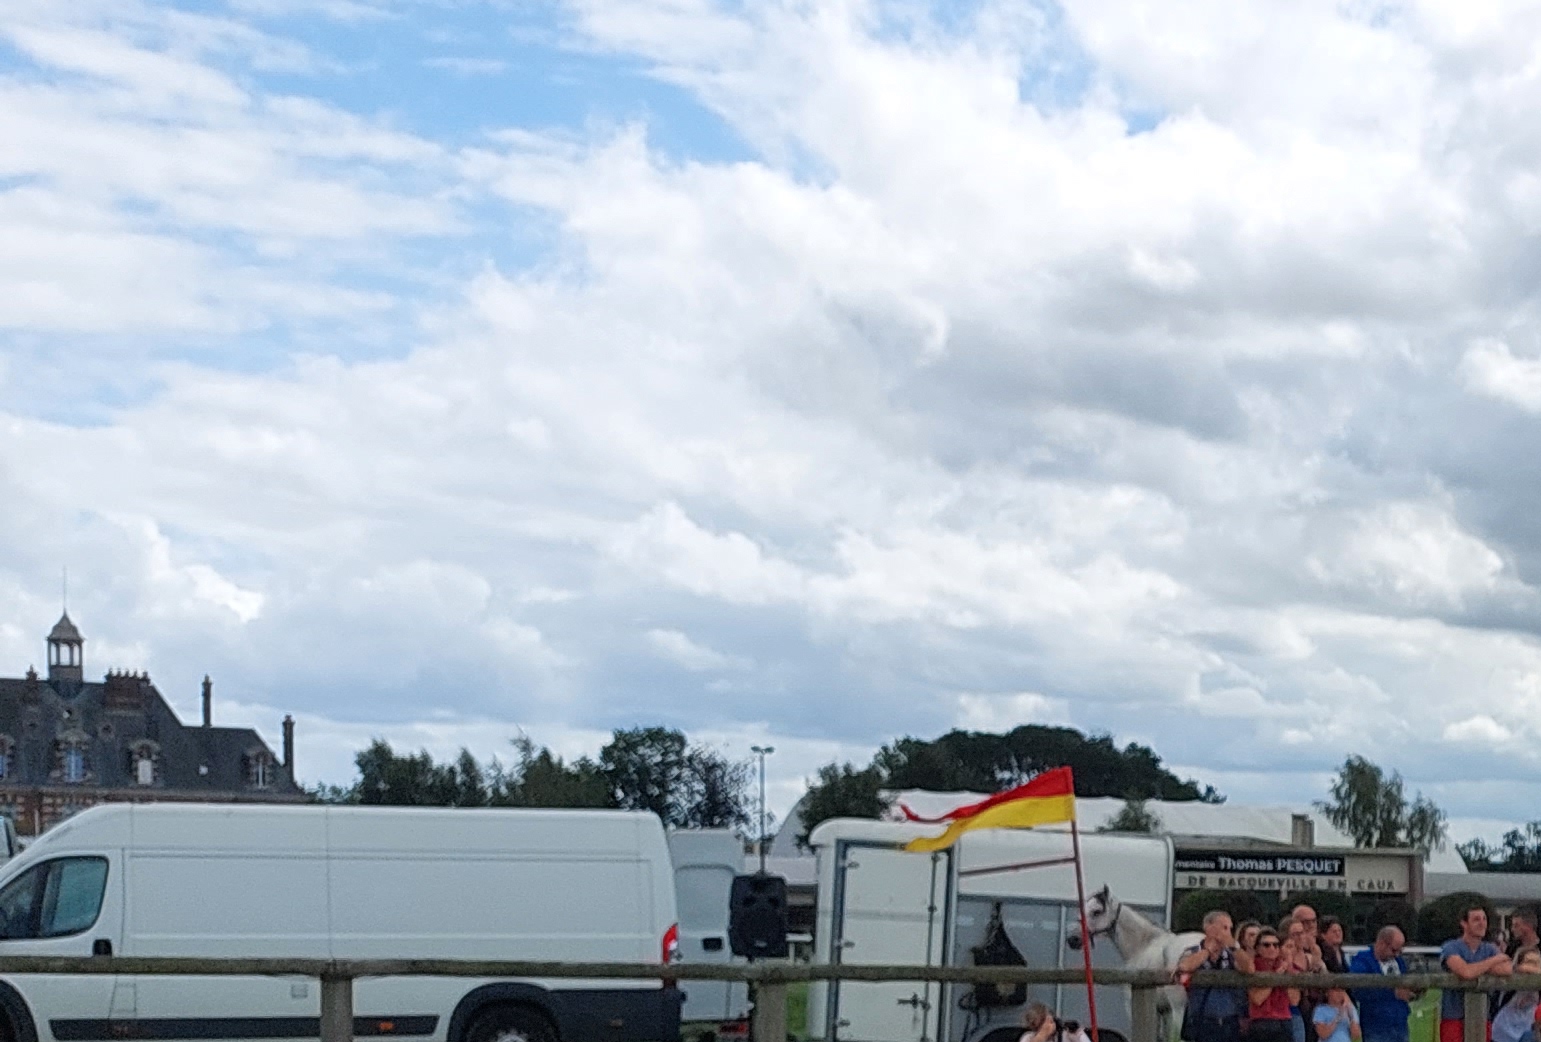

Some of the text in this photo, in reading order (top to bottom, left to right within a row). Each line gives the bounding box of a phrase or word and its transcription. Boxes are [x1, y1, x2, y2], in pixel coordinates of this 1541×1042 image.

[1174, 856, 1341, 874] mentaire Thomas PESQUET
[1188, 875, 1395, 890] DE BACQUEVILLE EN CAUX
